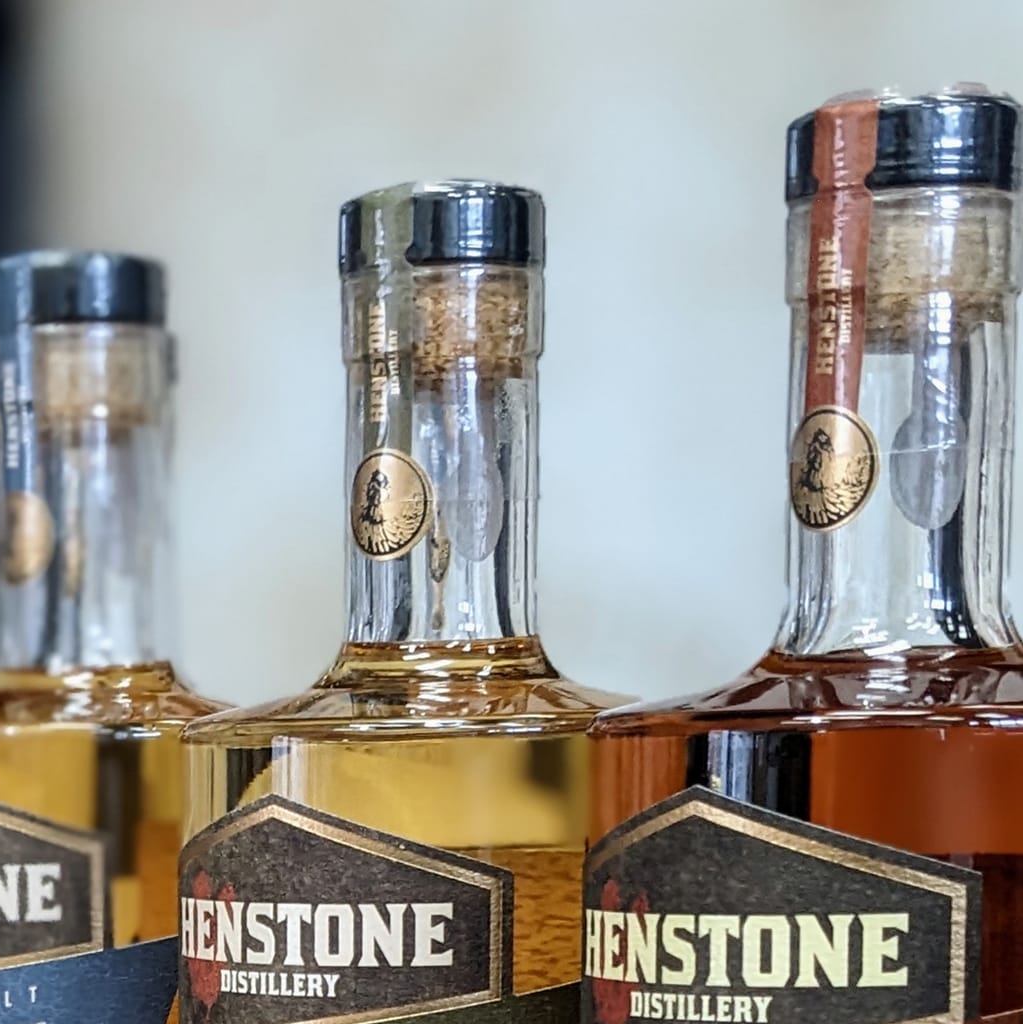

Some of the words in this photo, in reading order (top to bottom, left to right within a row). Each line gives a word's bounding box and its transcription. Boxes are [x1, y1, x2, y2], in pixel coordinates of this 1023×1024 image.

[814, 237, 841, 375] HENSTONE
[369, 303, 388, 423] HENSTONE
[181, 897, 454, 968] HENSTONE
[584, 908, 910, 988] HENSTONE
[220, 969, 340, 998] DISTILLERY
[630, 992, 773, 1024] DISTILLERY
